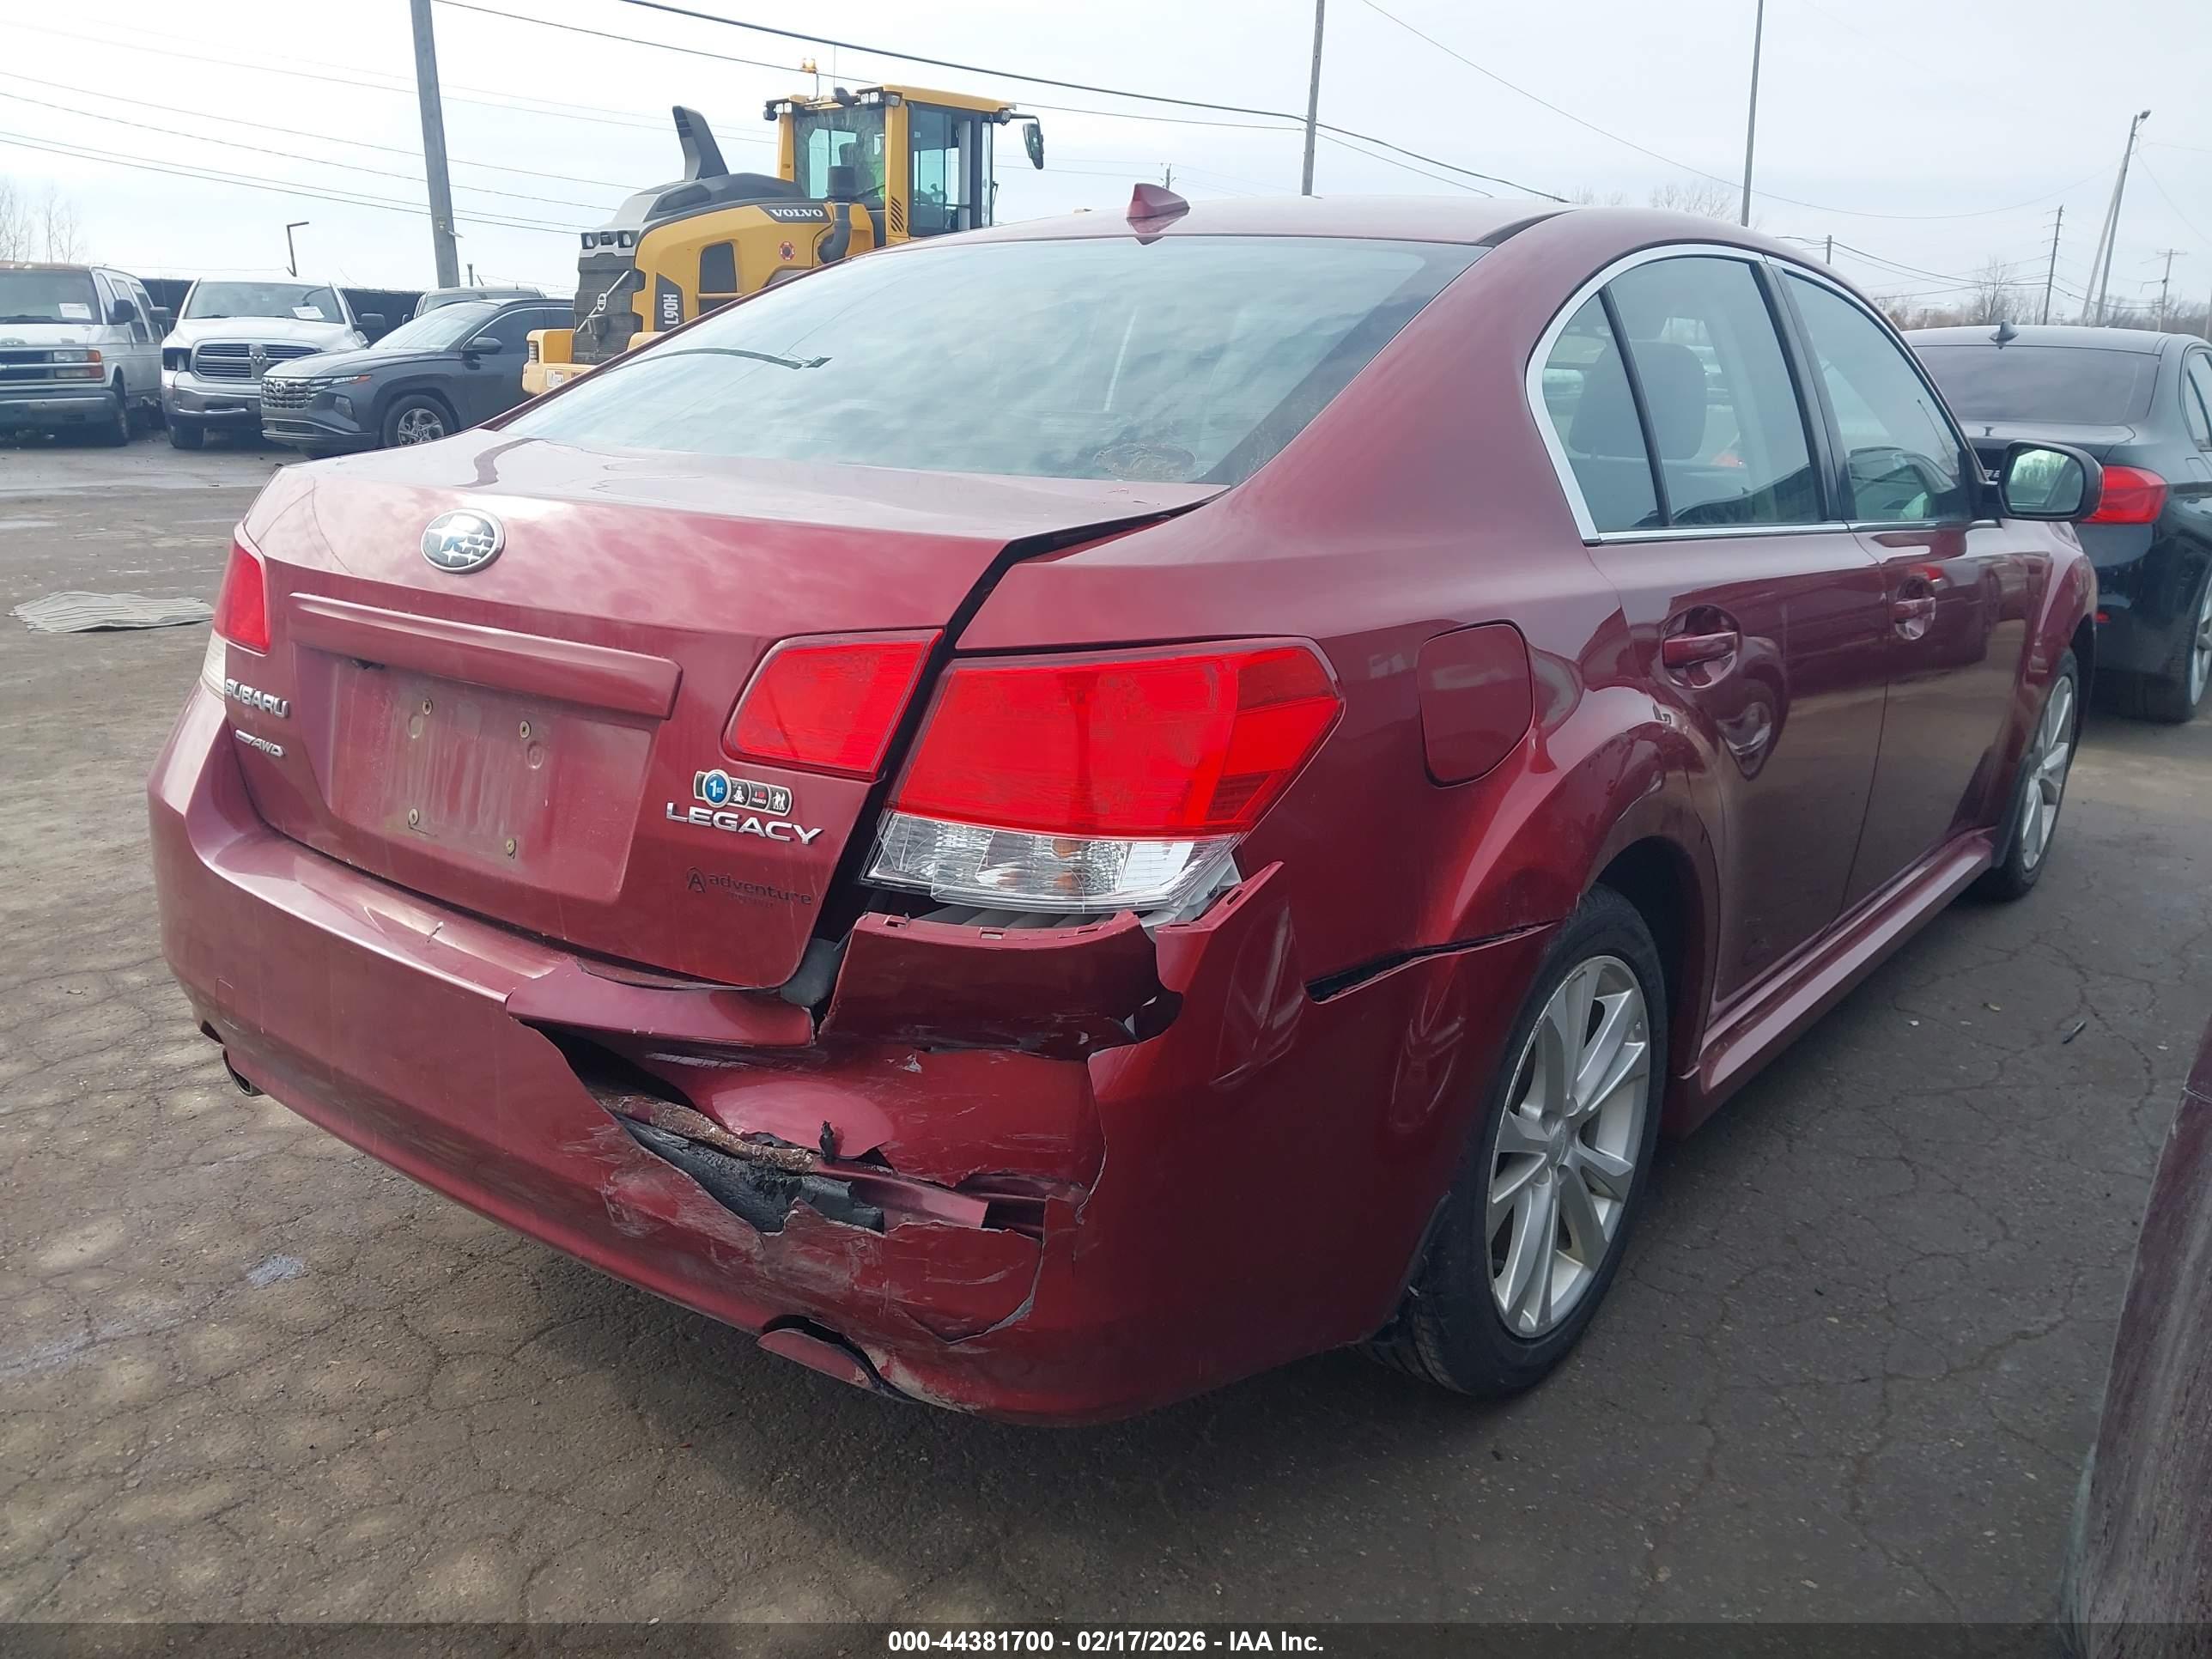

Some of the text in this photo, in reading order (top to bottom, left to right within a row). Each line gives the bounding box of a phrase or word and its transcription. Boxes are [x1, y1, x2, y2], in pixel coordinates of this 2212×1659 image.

[769, 209, 823, 217] VOLVO
[663, 294, 679, 325] L90H
[225, 678, 289, 718] SUBARU
[252, 738, 284, 757] AWD
[709, 780, 724, 797] 1st
[666, 802, 823, 845] LEGACY
[709, 874, 811, 905] adventure
